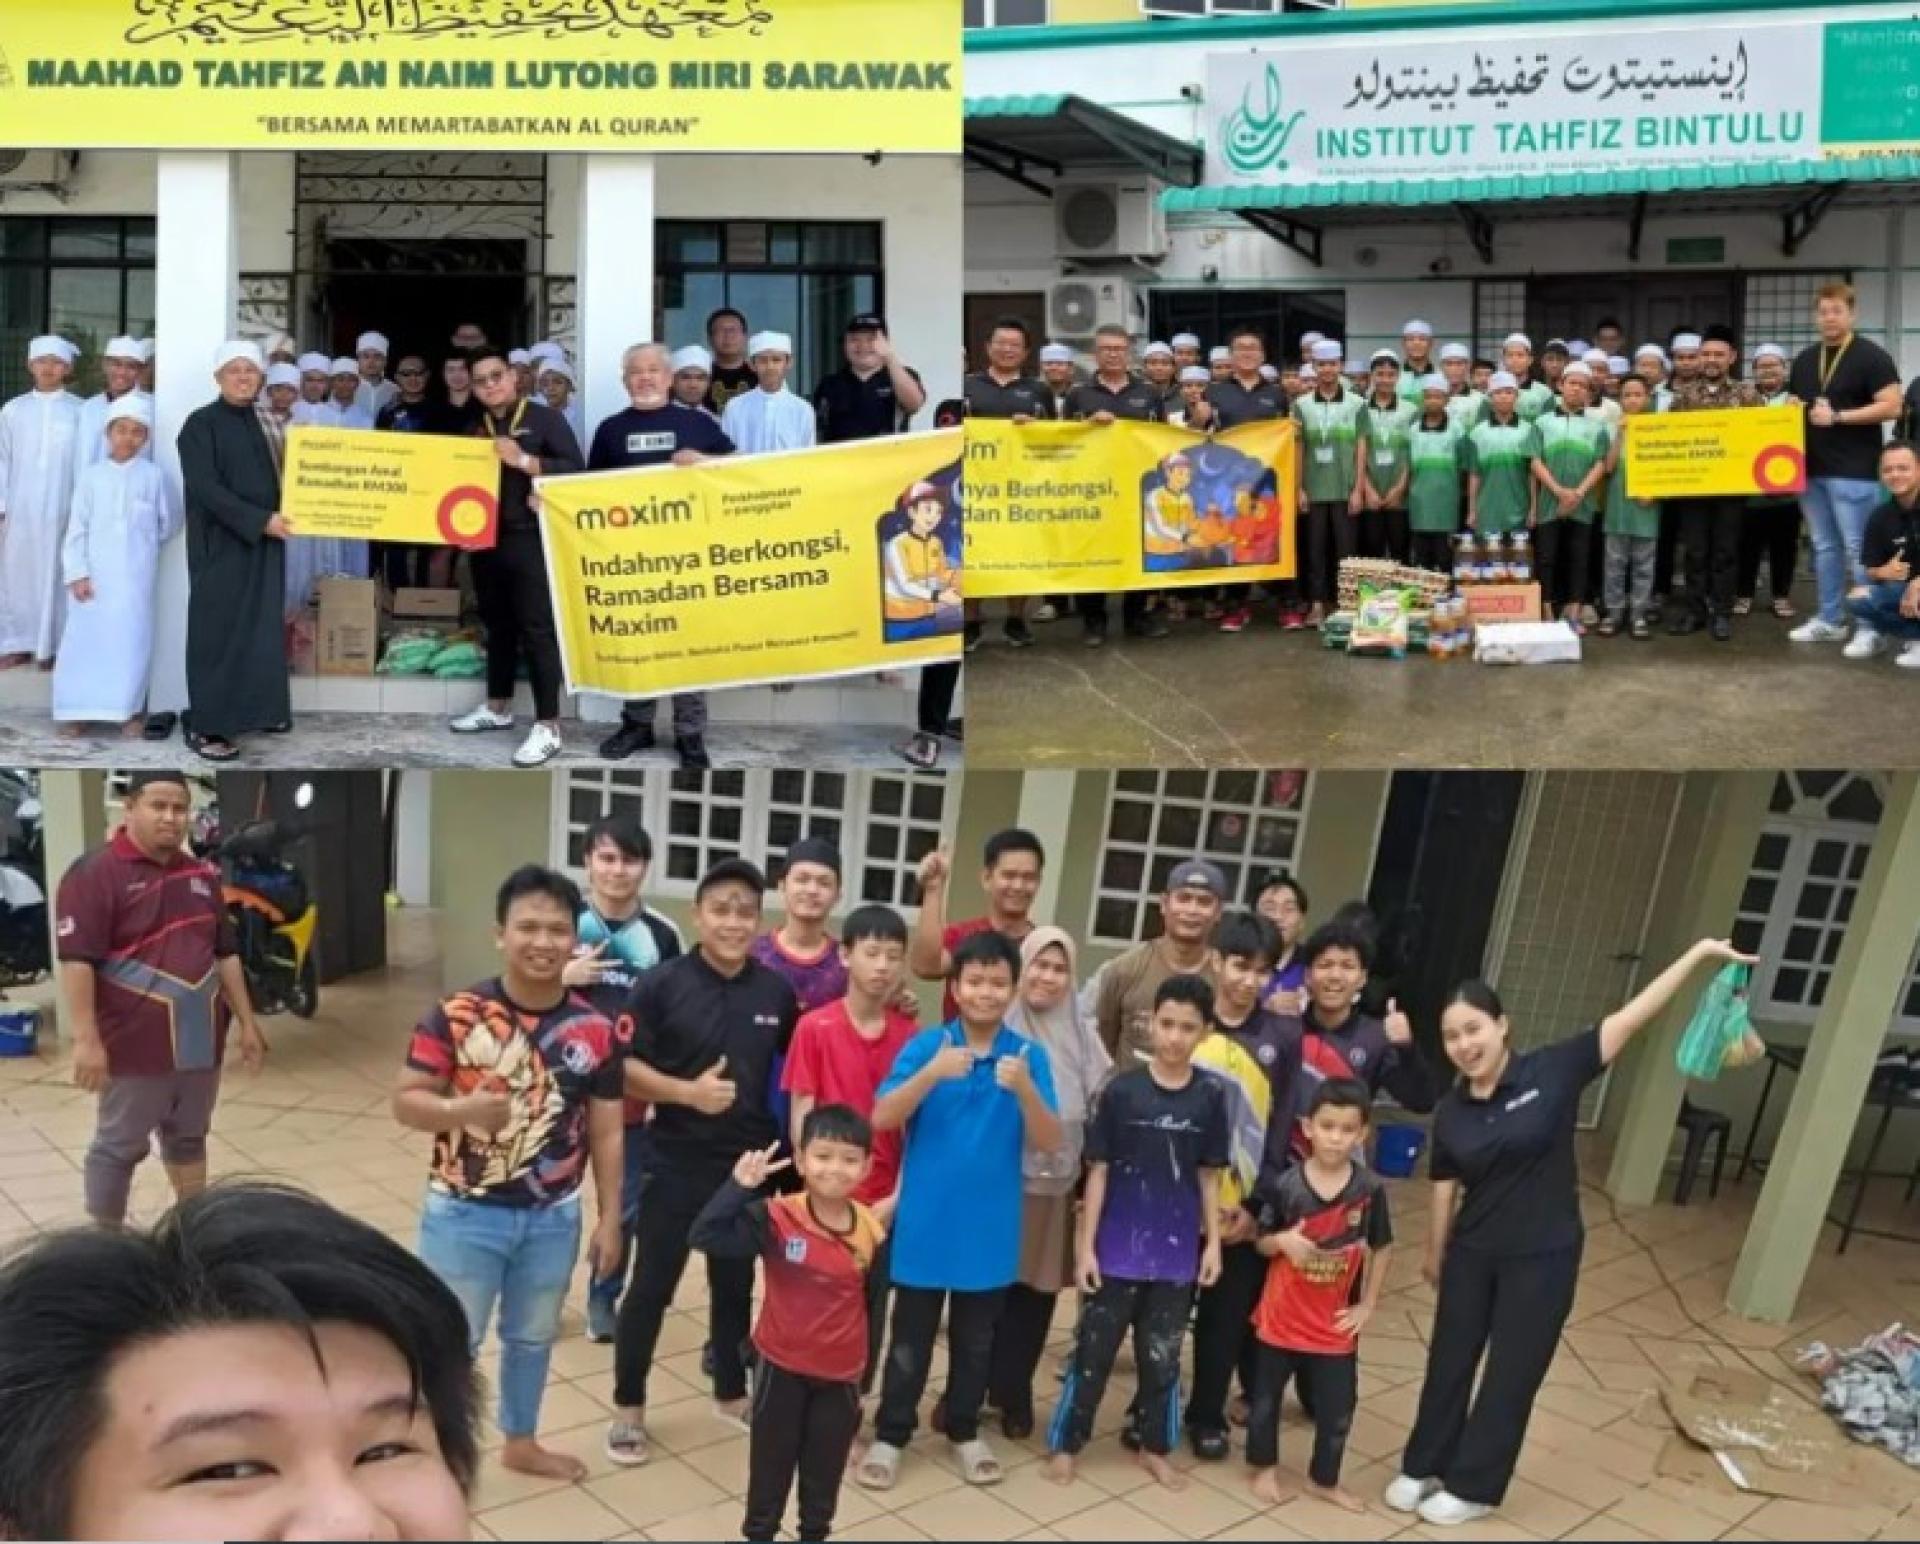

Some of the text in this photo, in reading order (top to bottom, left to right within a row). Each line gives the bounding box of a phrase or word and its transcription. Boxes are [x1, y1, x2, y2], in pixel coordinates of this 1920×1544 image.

[27, 59, 952, 90] MAAHAD TAHFIZ AN NAIM LUTONG MIRI SARAWAK
[376, 116, 571, 135] MEMARTABATKAN
[577, 117, 602, 135] AL
[1315, 110, 1804, 159] INSTITUT TAHFIZ BINTULU
[1006, 478, 1120, 502] Berkongsi,
[576, 496, 693, 529] maxim
[1007, 504, 1102, 523] Bersama
[580, 530, 850, 577] Indahnya Berkongsi,
[584, 568, 830, 607] Ramadan Bersama
[588, 613, 678, 637] Maxim
